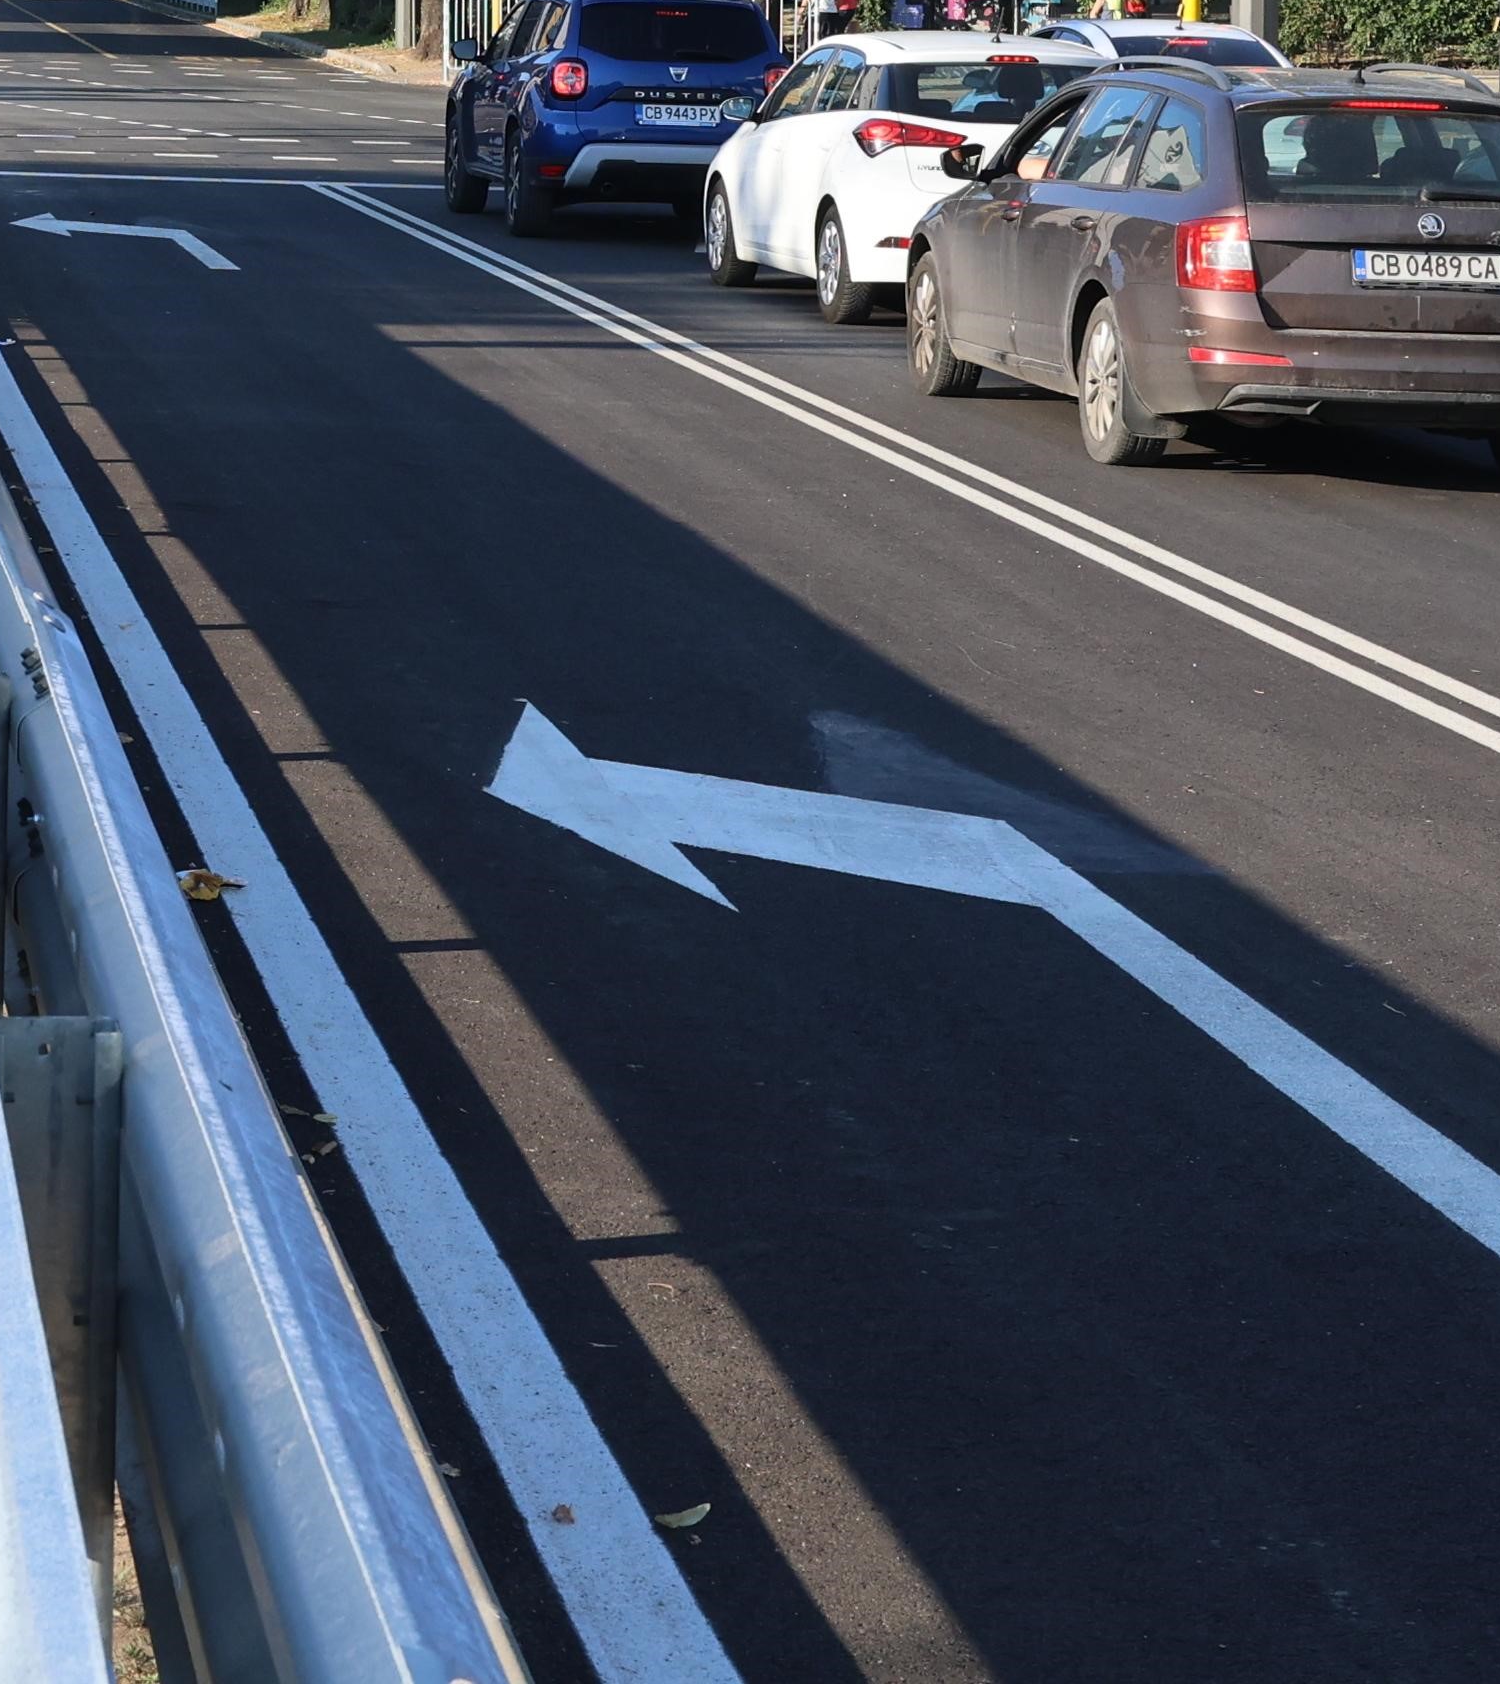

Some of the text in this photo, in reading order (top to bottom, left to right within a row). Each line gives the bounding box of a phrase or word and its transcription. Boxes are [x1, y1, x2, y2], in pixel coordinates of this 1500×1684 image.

[634, 91, 721, 99] DUSTER
[645, 106, 717, 121] CB 9443 PX
[1371, 254, 1498, 279] CB 0489 CA
